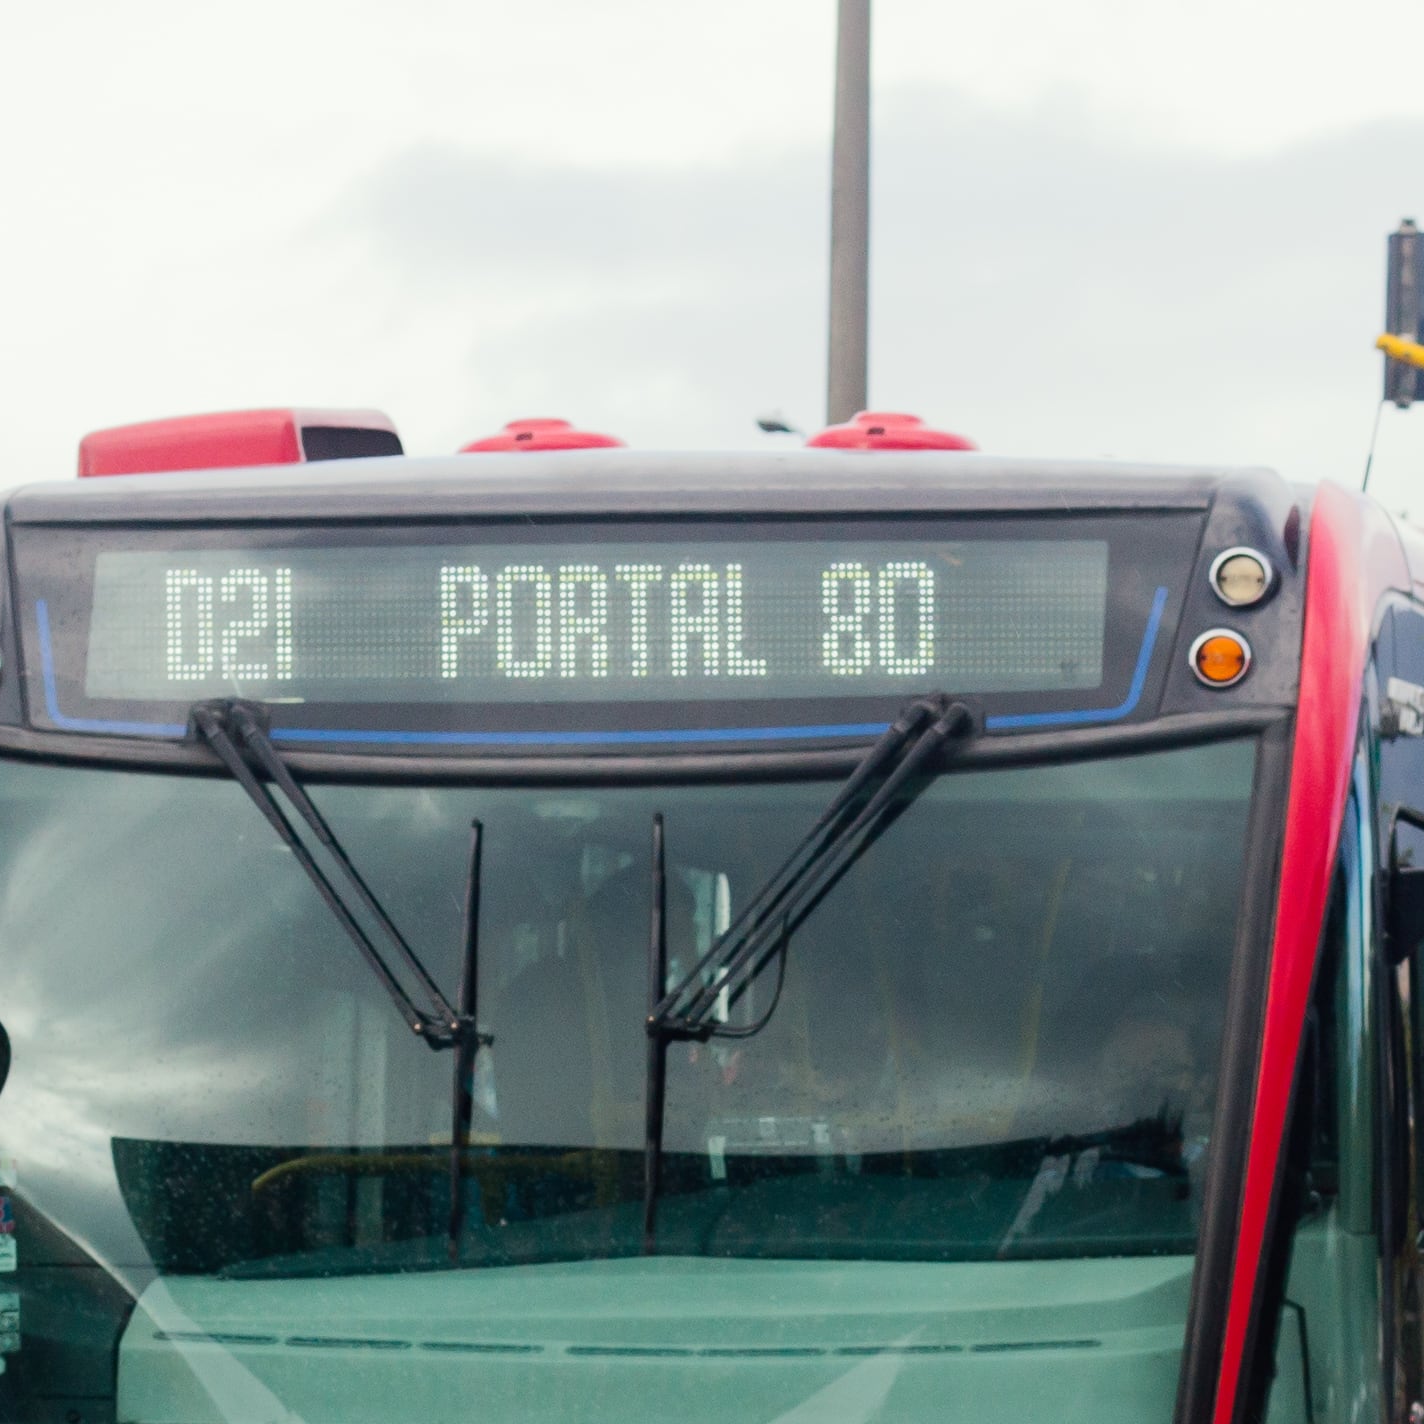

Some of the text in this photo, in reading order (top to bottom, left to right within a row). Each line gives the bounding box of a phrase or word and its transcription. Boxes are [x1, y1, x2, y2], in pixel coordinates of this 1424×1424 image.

[166, 562, 935, 681] D21 PORTAL 80
